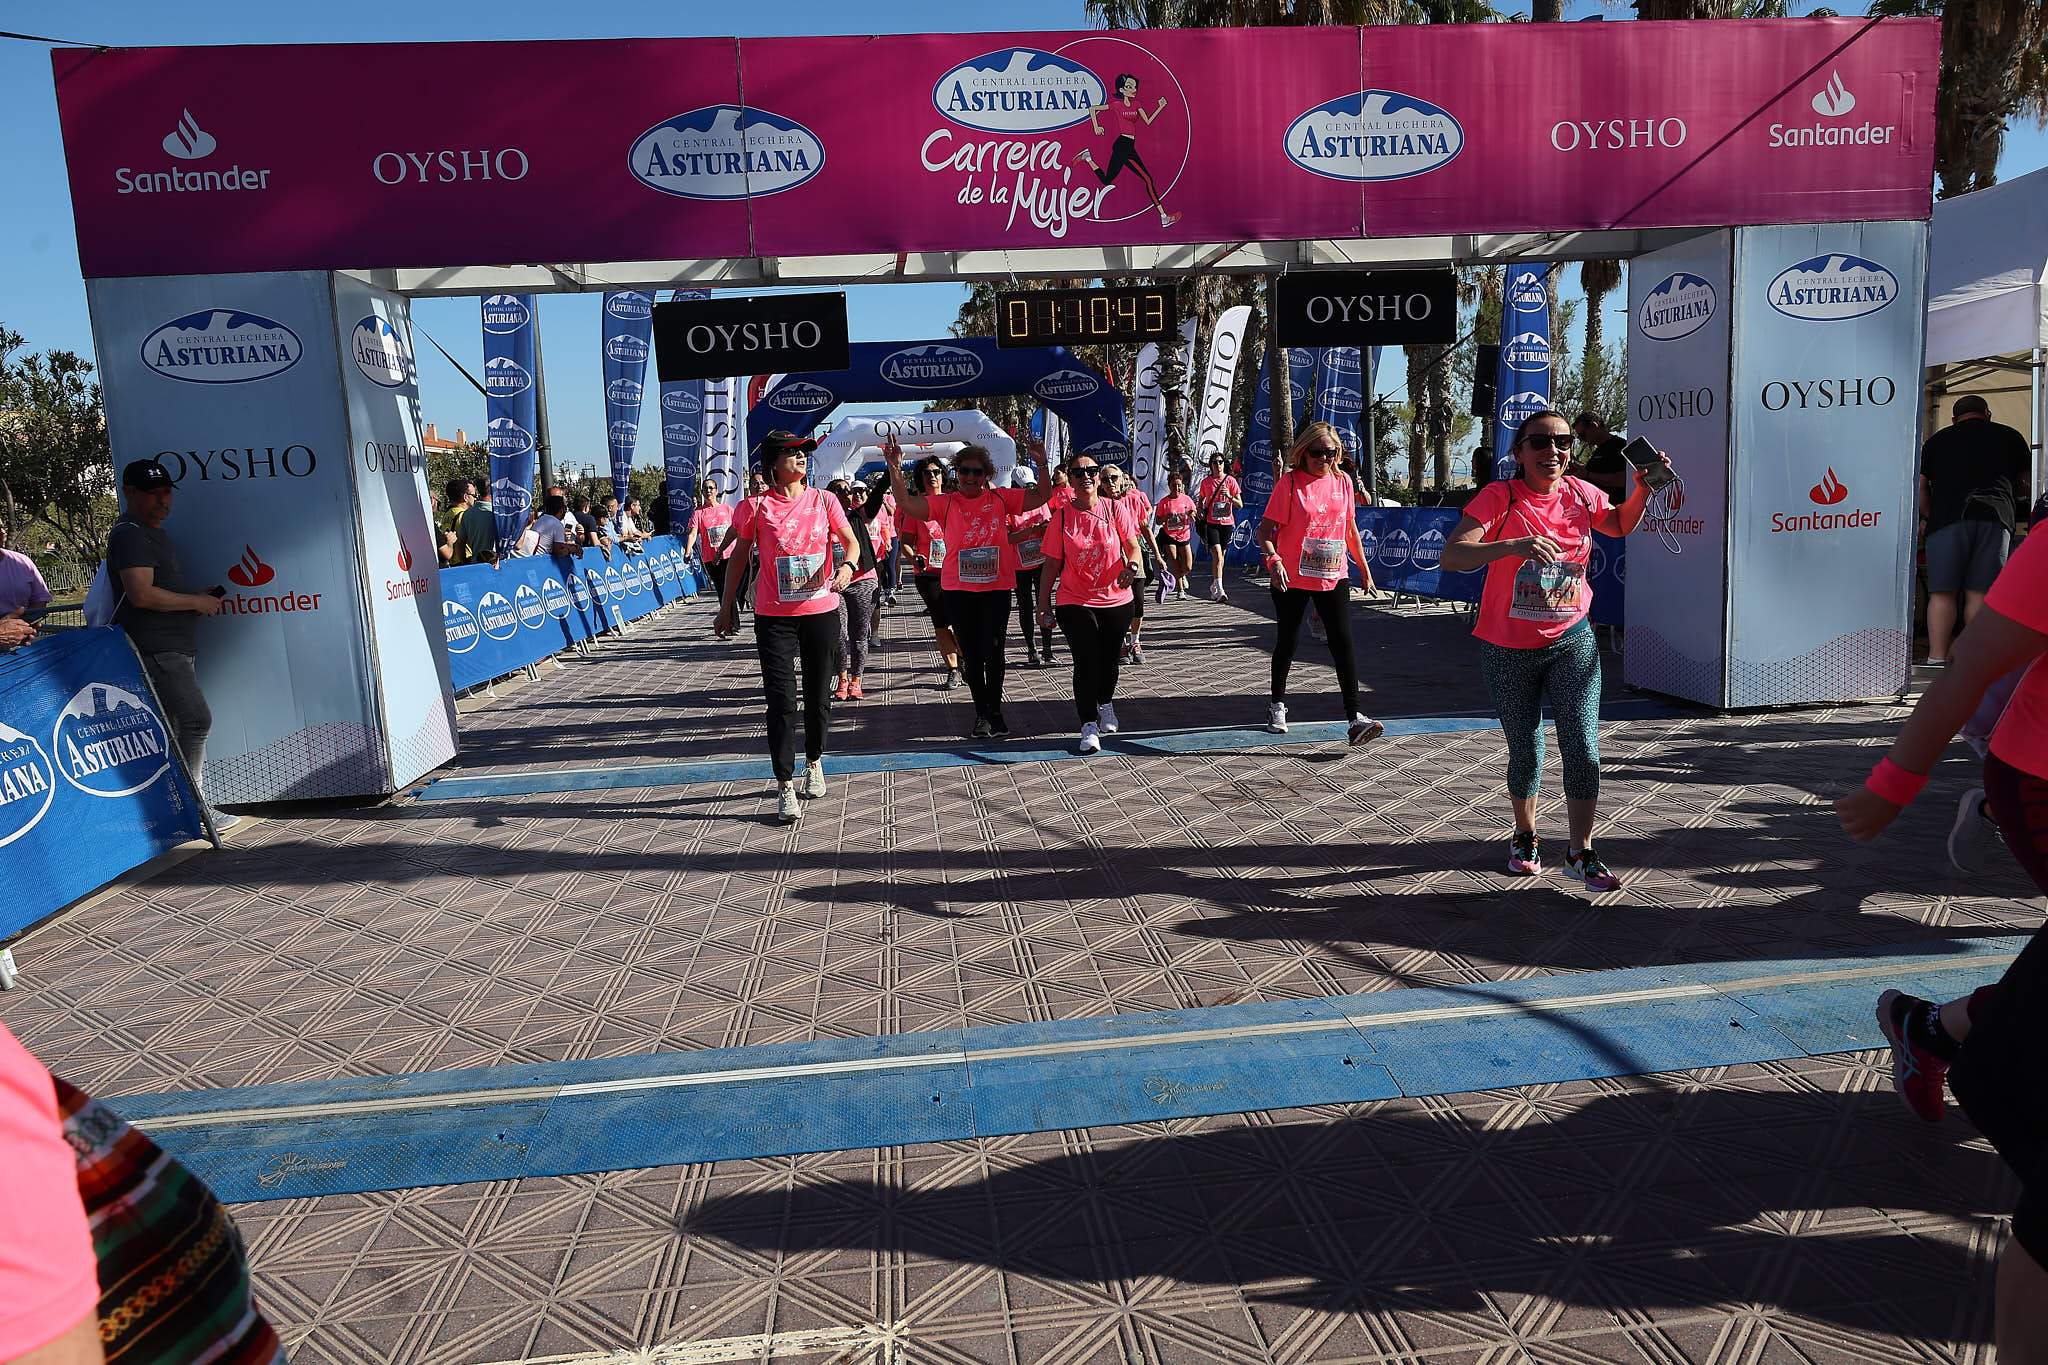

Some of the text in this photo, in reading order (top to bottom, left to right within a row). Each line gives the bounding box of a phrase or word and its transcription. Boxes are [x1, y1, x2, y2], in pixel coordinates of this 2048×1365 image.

[947, 80, 1092, 112] ASTURIANA
[972, 76, 1088, 87] CENTRAL LECHERA
[1325, 119, 1445, 132] CENTRAL LECHERA
[1551, 117, 1687, 152] OYSHO
[1769, 121, 1895, 148] Santander
[673, 135, 803, 149] CENTRAL ECHERA
[920, 128, 1062, 172] Carrera
[1298, 125, 1450, 158] ASTURIANA
[373, 148, 529, 185] OYSHO
[645, 141, 811, 178] ASTURIANA
[116, 165, 270, 194] Santander
[957, 166, 1115, 238] de la Mujer
[1776, 281, 1889, 306] ASTURIANA
[1797, 275, 1885, 286] CENTRAL LECHERA
[1307, 294, 1431, 323] OYSHO
[1643, 298, 1710, 330] ASTURIANA
[176, 332, 284, 344] CENTRAL LECHERA
[687, 320, 821, 354] OYSHO
[154, 339, 292, 368] ASTURIANA
[888, 360, 977, 379] ASTURIANA
[773, 395, 828, 406] ASTURIANA
[1039, 381, 1095, 396] ASTURIANA
[1198, 331, 1236, 468] OYSHO
[1761, 377, 1895, 411] OYSHO
[1639, 387, 1714, 422] OYSHO
[874, 417, 954, 438] OYSHO
[1136, 366, 1160, 480] OYSHO
[152, 445, 316, 483] OYSHO
[365, 442, 421, 474] OYSHO
[1643, 514, 1704, 535] Santander
[1772, 508, 1881, 532] Santander
[386, 576, 429, 601] Santander
[219, 591, 322, 616] ntander
[445, 621, 478, 643] STURIANA
[77, 711, 149, 740] CENTRAL LECHER
[69, 728, 163, 780] ASTURIAN
